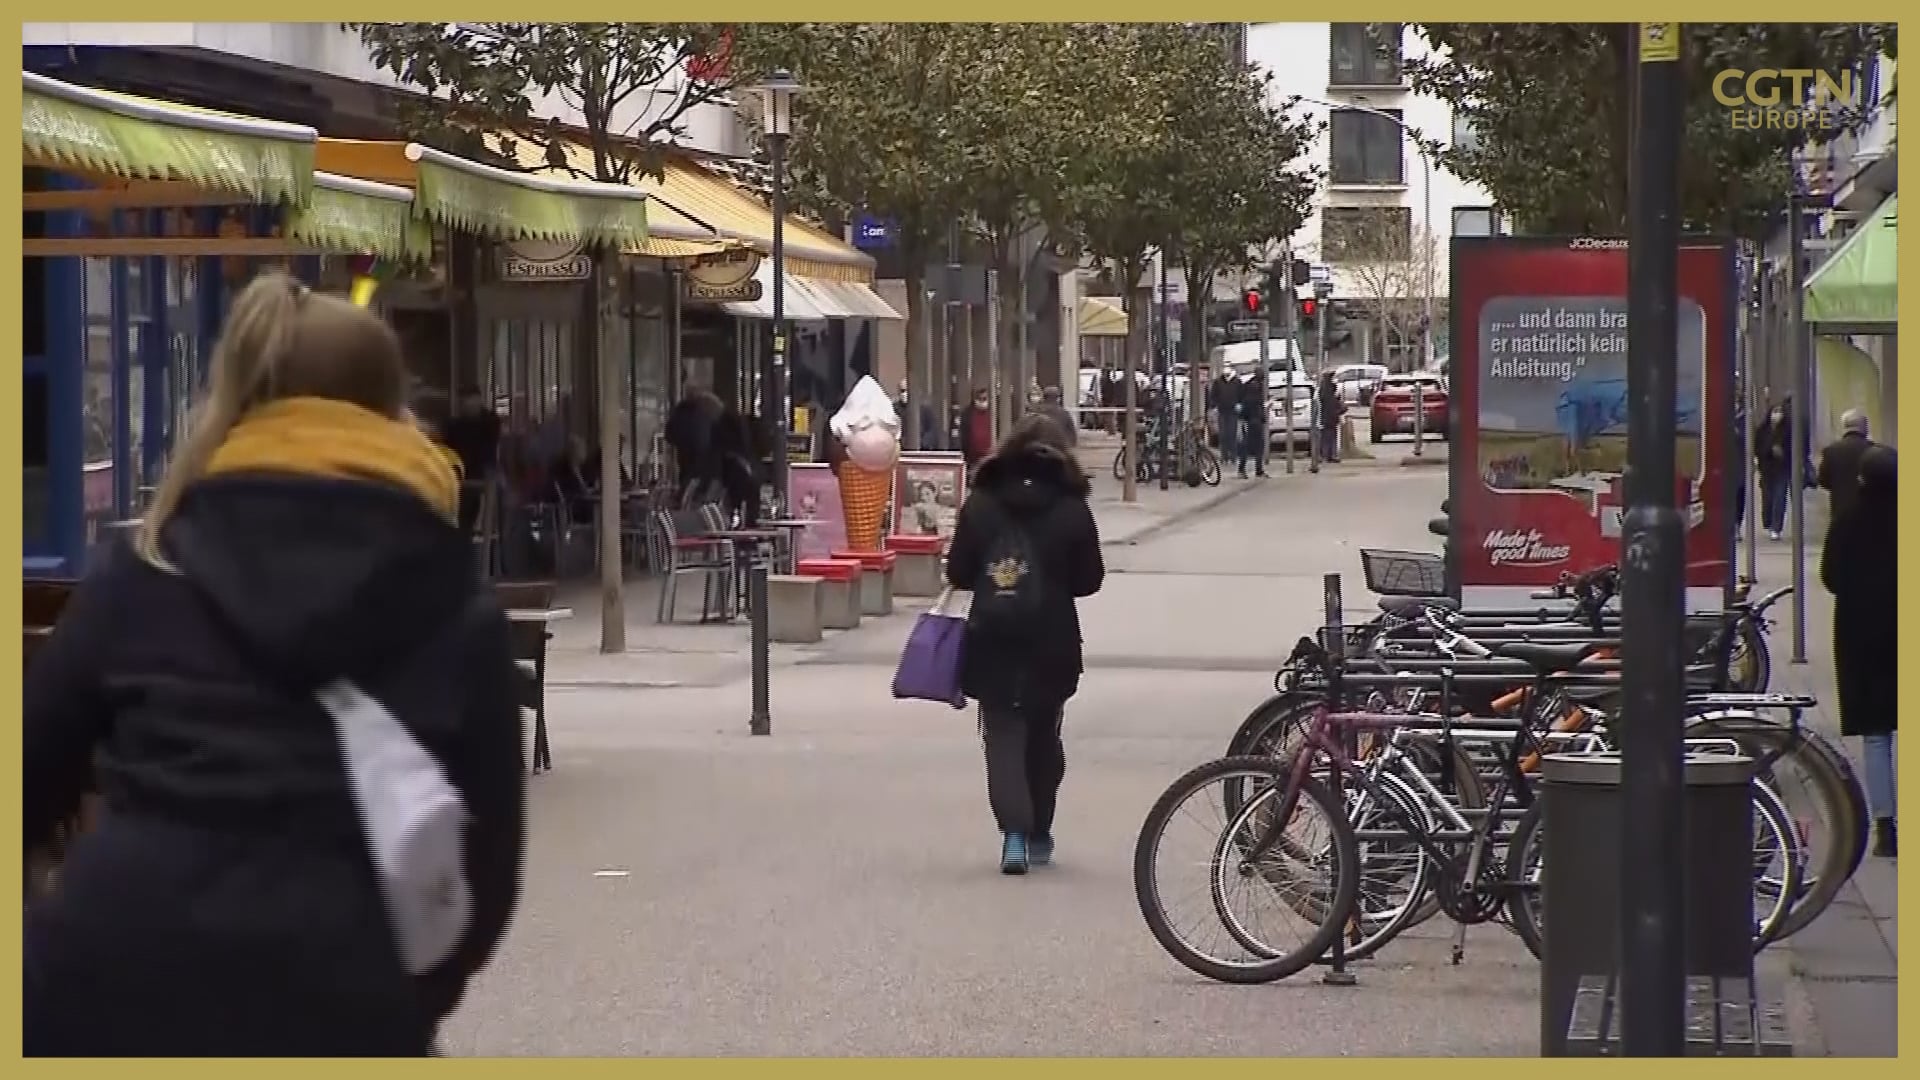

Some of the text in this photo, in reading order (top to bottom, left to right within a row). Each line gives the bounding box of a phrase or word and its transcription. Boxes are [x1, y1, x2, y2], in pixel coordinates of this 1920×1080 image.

[506, 260, 583, 277] ESPRESSO
[1519, 307, 1551, 329] und
[1555, 307, 1596, 329] dann
[1491, 337, 1508, 353] er
[1511, 332, 1587, 353] natürlich
[1482, 529, 1527, 549] Made
[1489, 542, 1571, 567] good times
